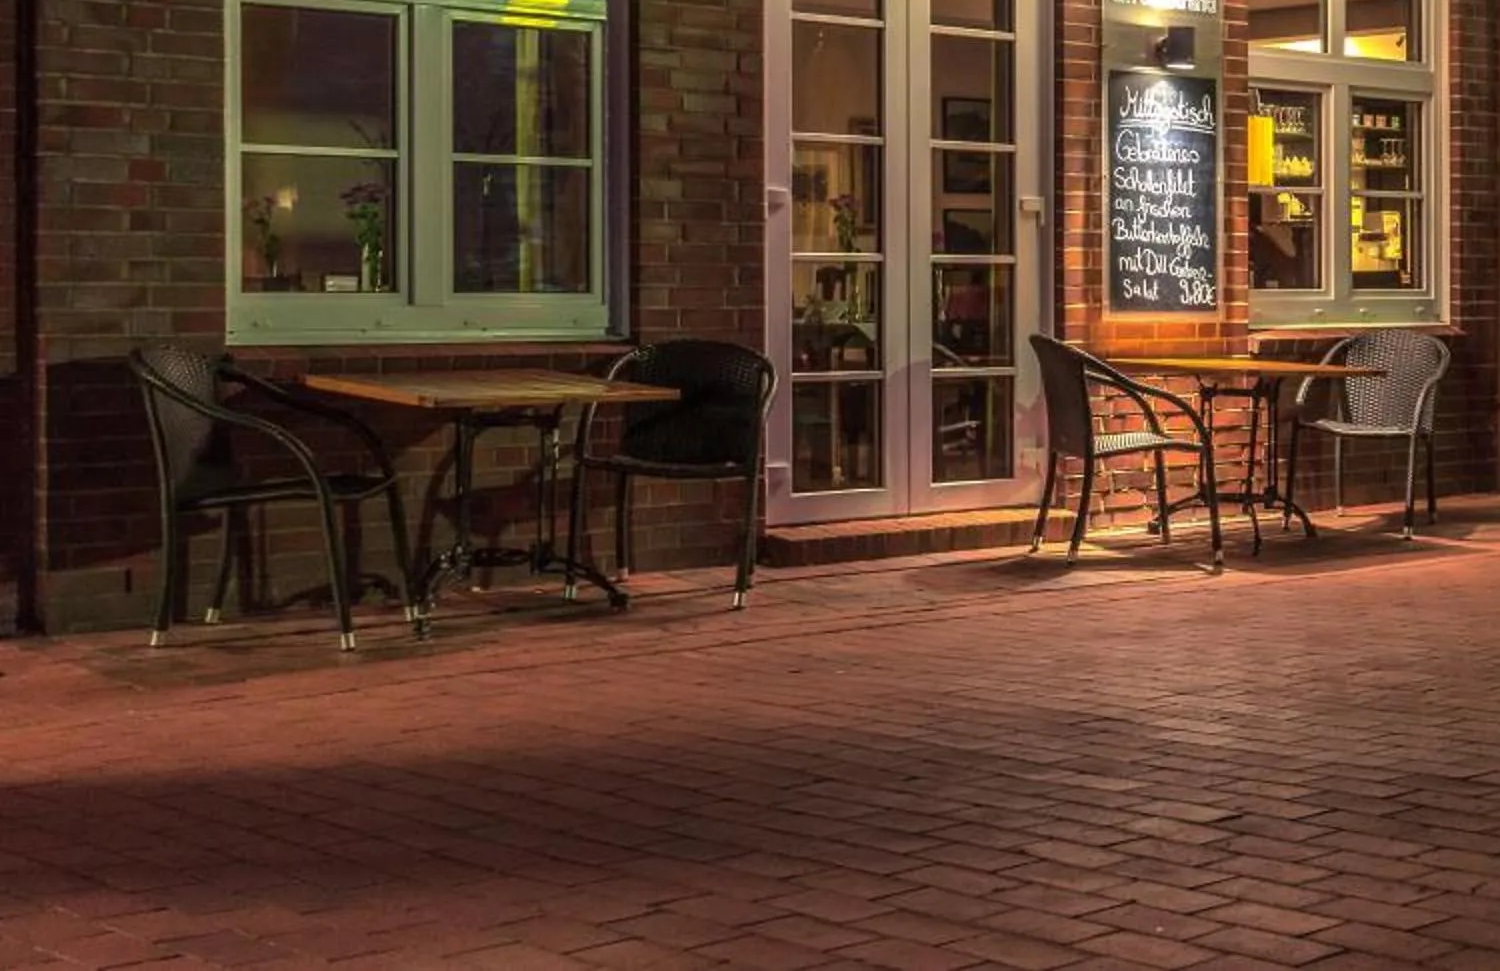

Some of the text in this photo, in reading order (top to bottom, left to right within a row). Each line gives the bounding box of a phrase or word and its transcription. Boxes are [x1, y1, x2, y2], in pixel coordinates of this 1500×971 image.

[1115, 198, 1134, 211] an
[1119, 246, 1143, 272] mit
[1123, 278, 1159, 301] Salat
